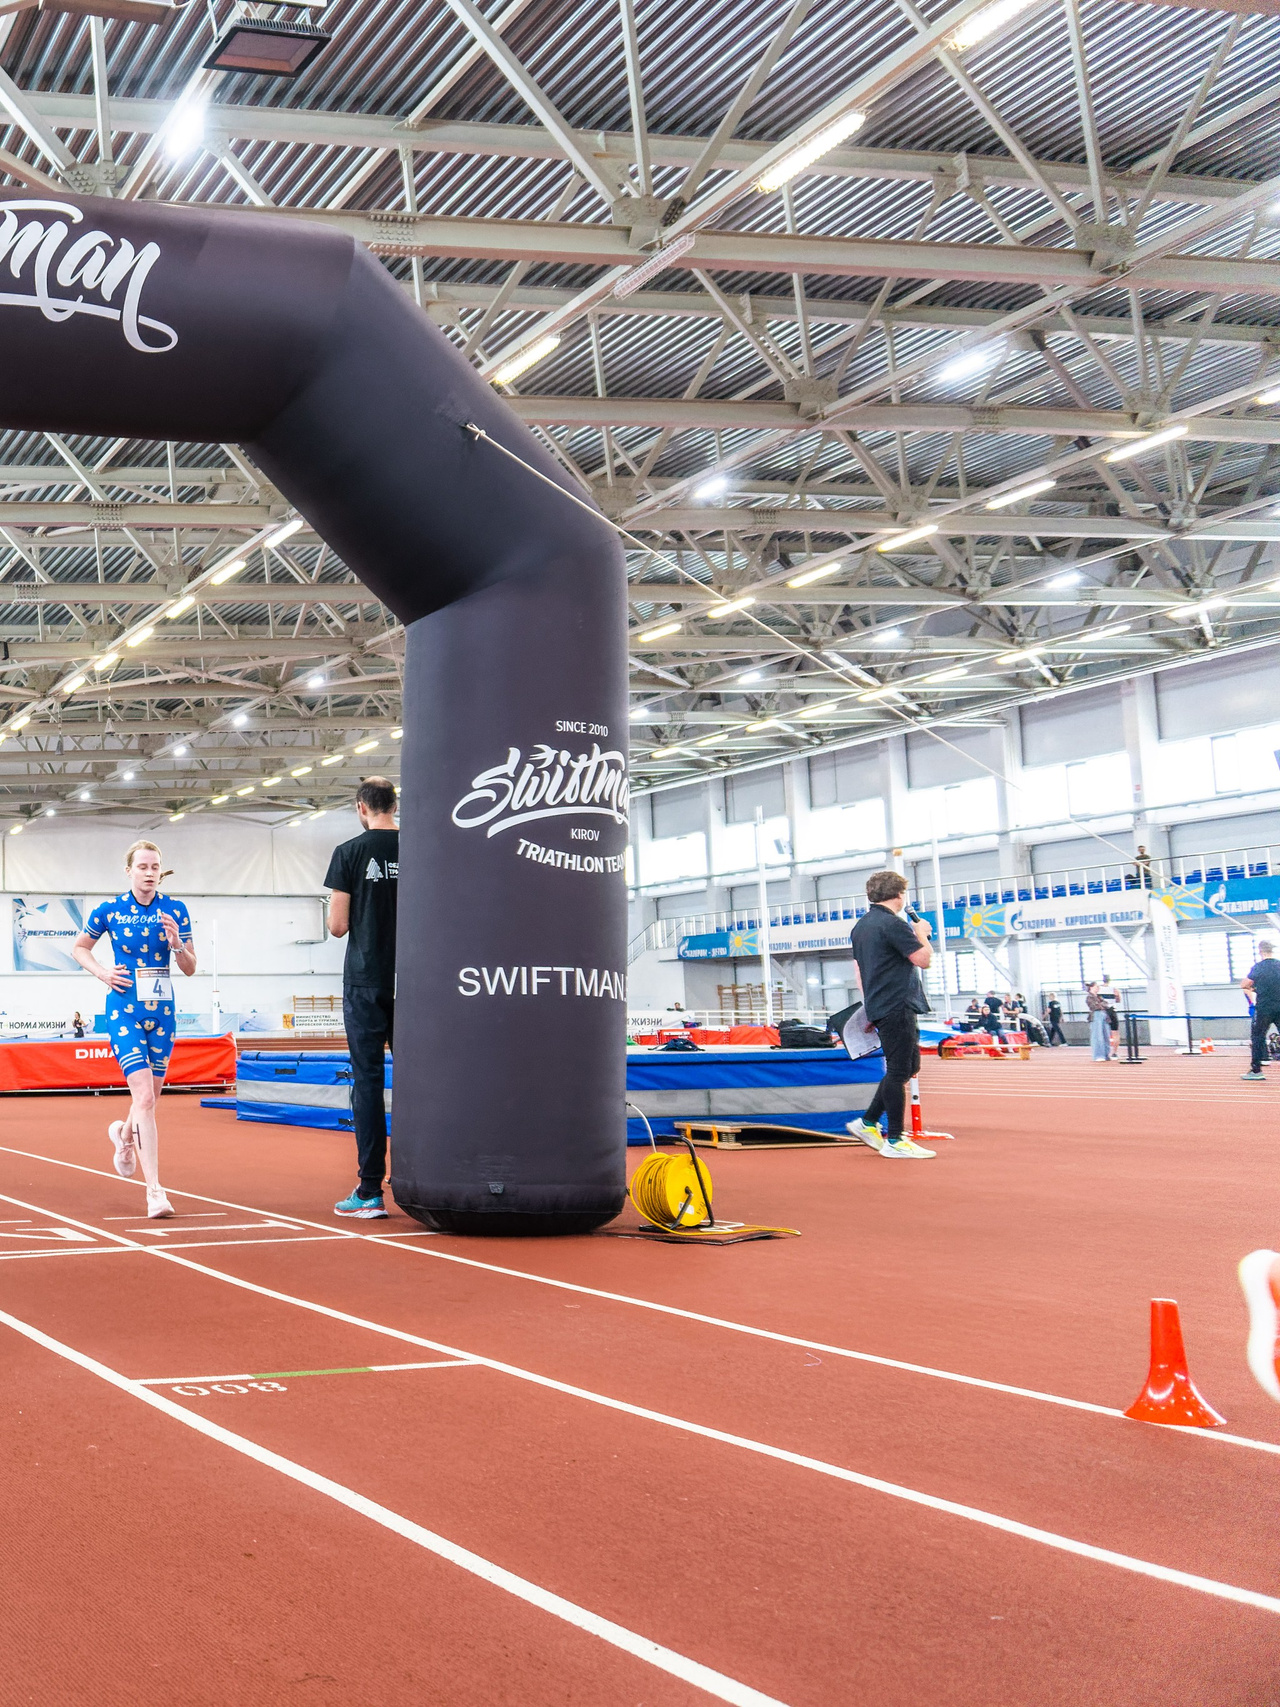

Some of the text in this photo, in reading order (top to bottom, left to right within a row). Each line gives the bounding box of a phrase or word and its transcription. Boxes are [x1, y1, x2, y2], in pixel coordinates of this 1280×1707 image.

[556, 720, 609, 737] SINCE 2010
[571, 828, 601, 842] KIROV
[516, 838, 604, 873] TRIATHLON
[153, 978, 163, 997] 4
[9, 1021, 37, 1029] НОРМА
[632, 1018, 662, 1026] ЖИЗНИ
